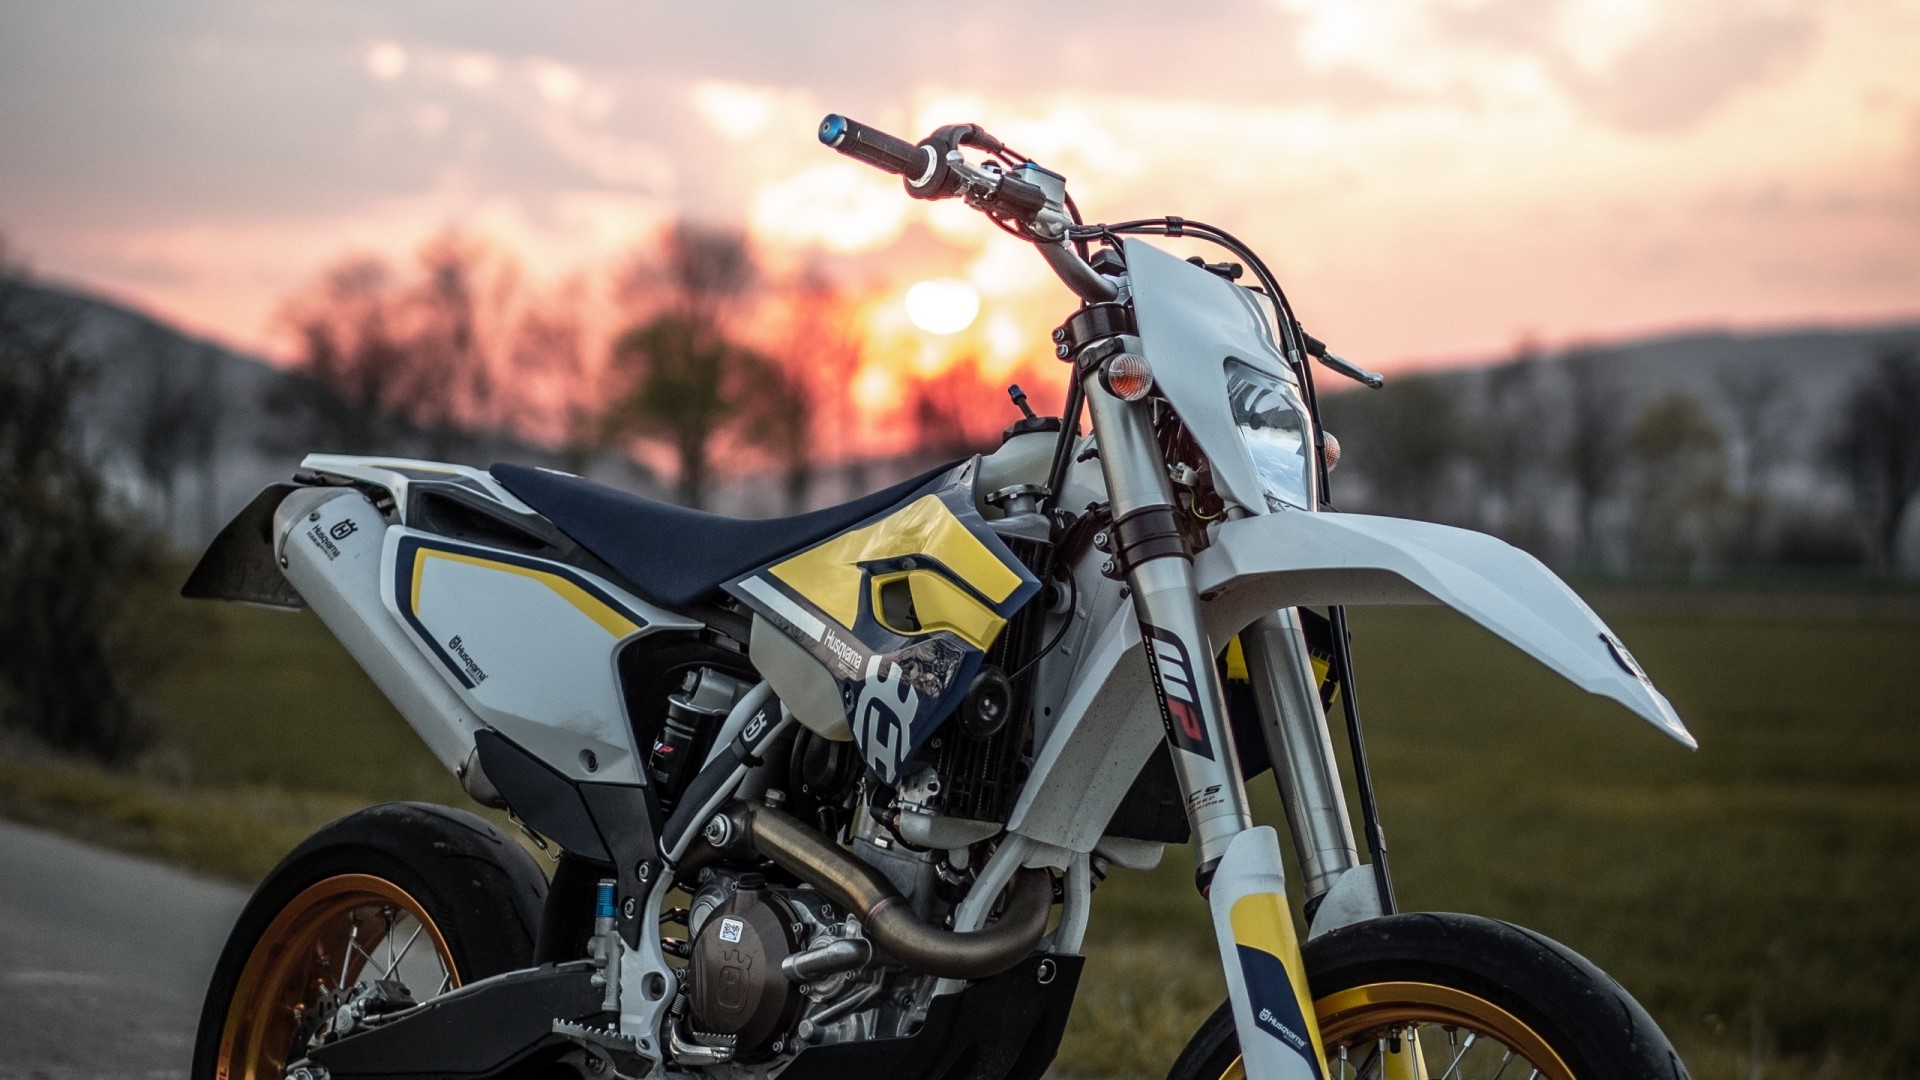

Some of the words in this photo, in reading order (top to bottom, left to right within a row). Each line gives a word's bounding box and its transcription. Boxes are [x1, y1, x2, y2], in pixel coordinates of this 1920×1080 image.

[312, 523, 341, 558] Husqvarna
[455, 644, 486, 682] Husqvarna
[823, 628, 863, 669] Husqvarna
[1151, 637, 1203, 742] WP
[1268, 1015, 1305, 1047] Husqvarna
